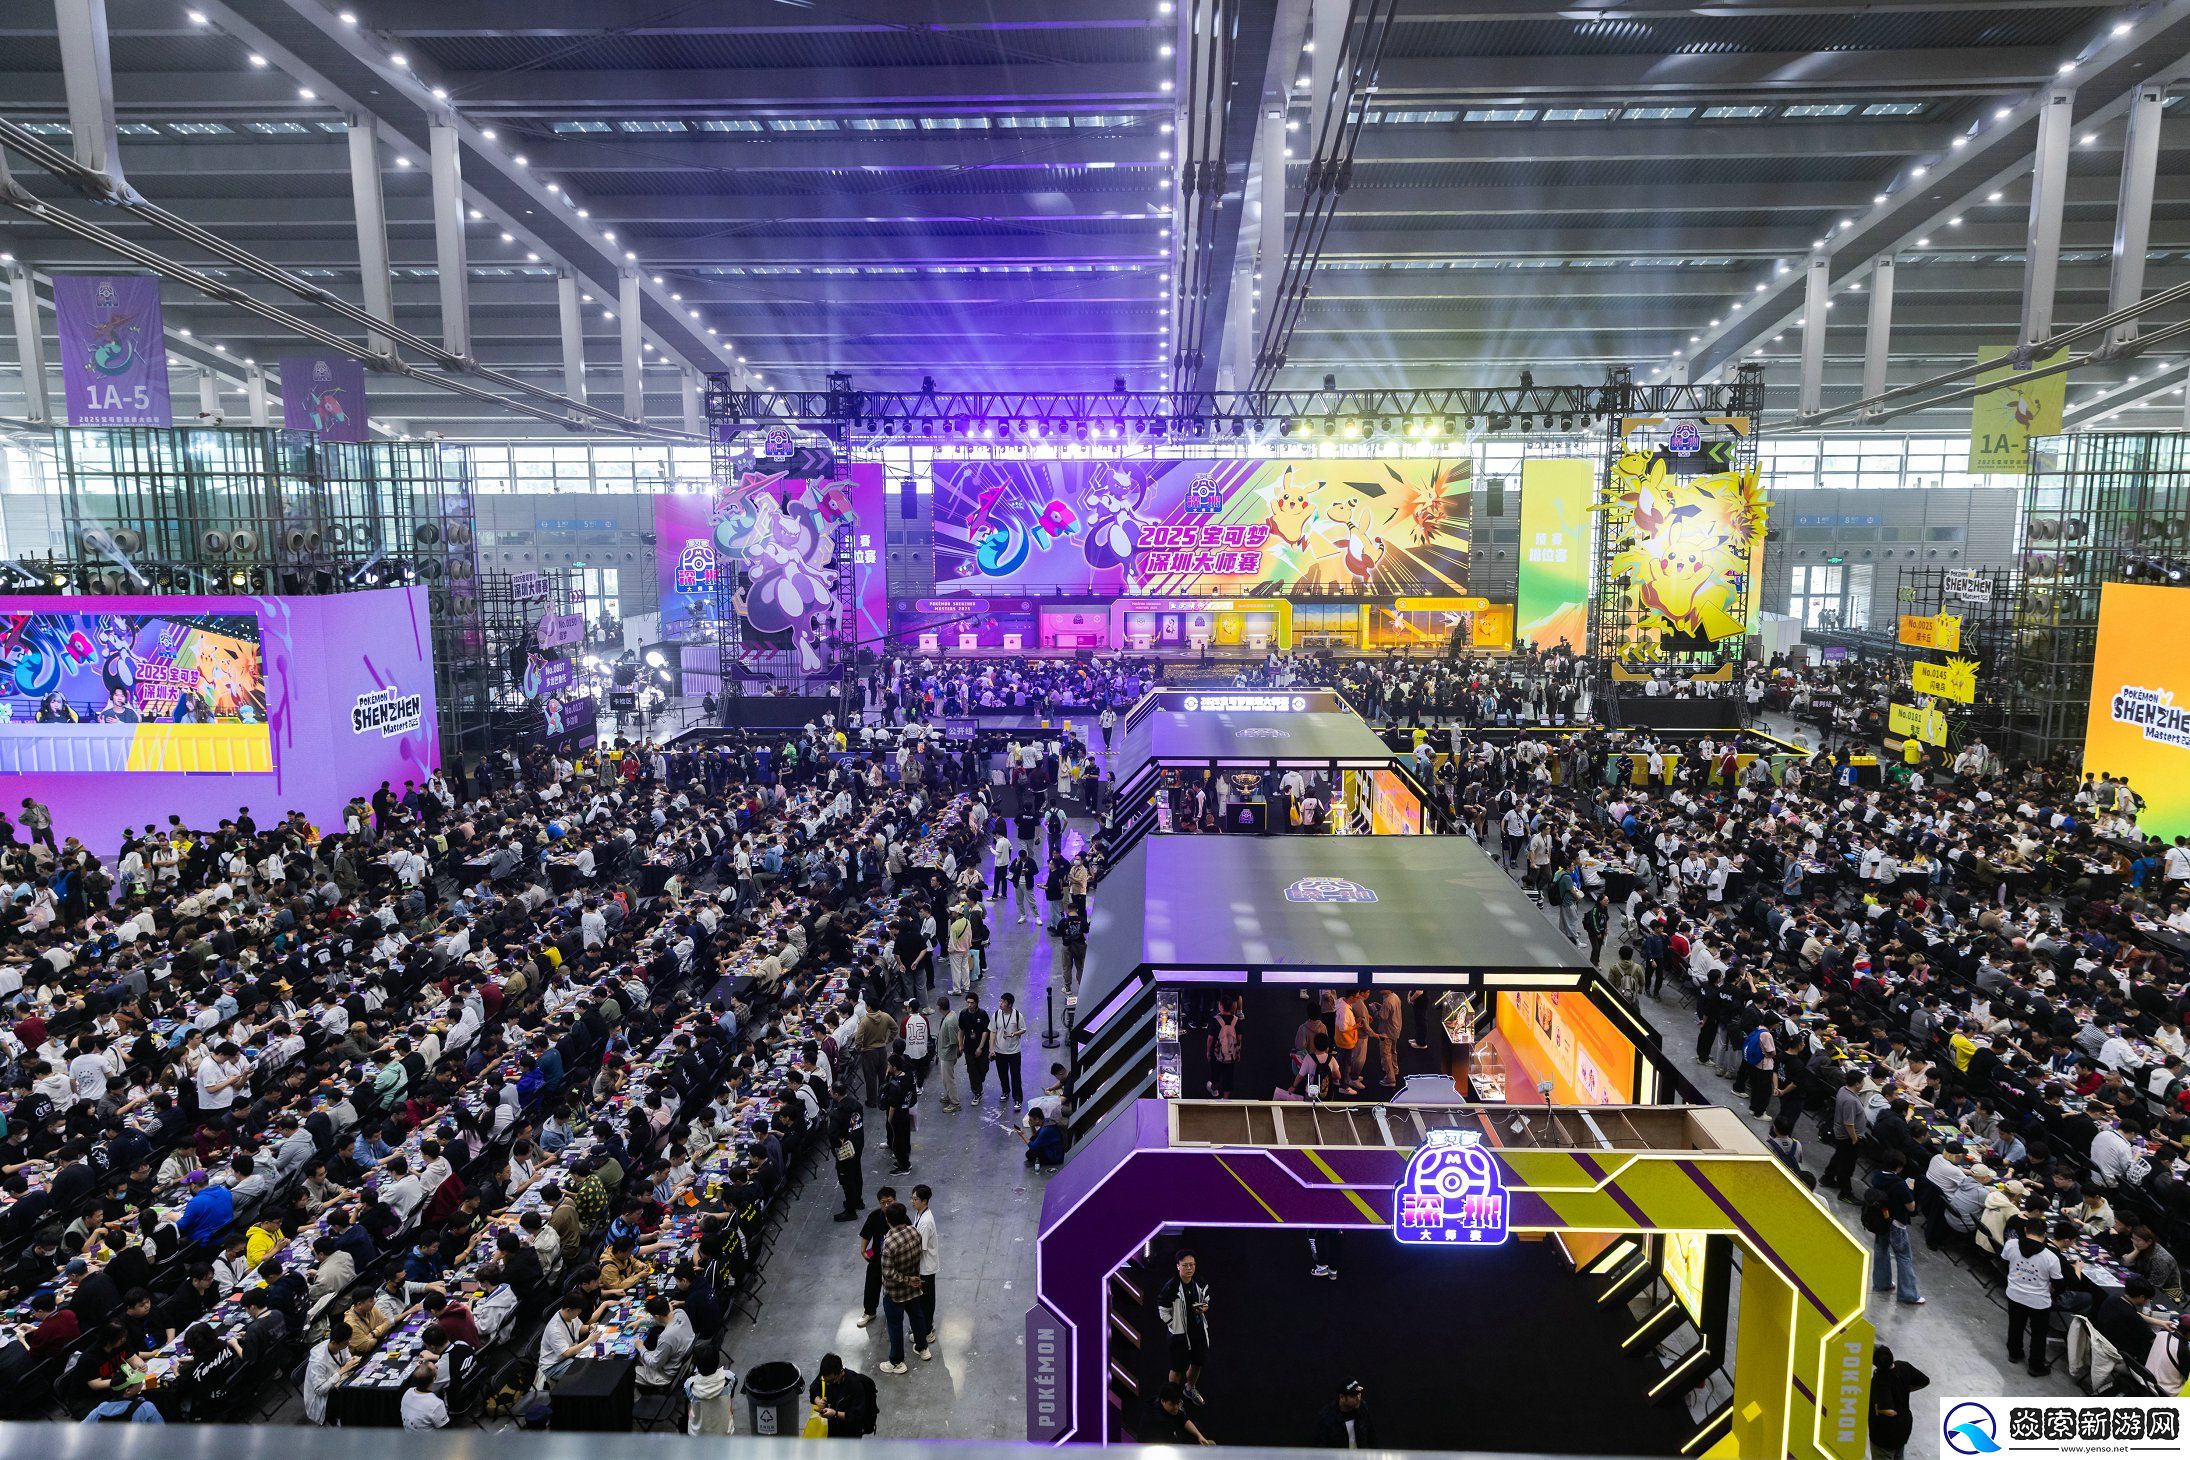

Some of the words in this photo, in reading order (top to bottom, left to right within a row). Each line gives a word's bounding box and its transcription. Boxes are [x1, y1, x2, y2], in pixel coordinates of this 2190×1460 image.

[86, 384, 150, 410] 1A-5
[1138, 526, 1198, 548] 2025
[1200, 525, 1270, 547] 宝可梦
[1146, 551, 1262, 574] 深圳大师赛
[1945, 576, 1992, 593] SHENZHEN
[1908, 619, 1933, 631] No.0025
[135, 663, 168, 680] 2025
[169, 666, 201, 684] 宝可梦
[1922, 666, 1947, 680] No.0145
[359, 692, 388, 707] POKÉMON
[2123, 688, 2159, 704] POKÉMON
[353, 696, 420, 731] SHENZHEN
[1898, 708, 1922, 723] No.0181
[382, 720, 408, 735] Masters
[948, 726, 974, 736] 公开组
[2145, 726, 2180, 744] Masters
[907, 1022, 926, 1041] 12
[1445, 1153, 1462, 1165] M
[1419, 1229, 1482, 1241] 大师赛
[1033, 1328, 1056, 1428] POKÉMON
[1836, 1341, 1863, 1443] POKÉMON
